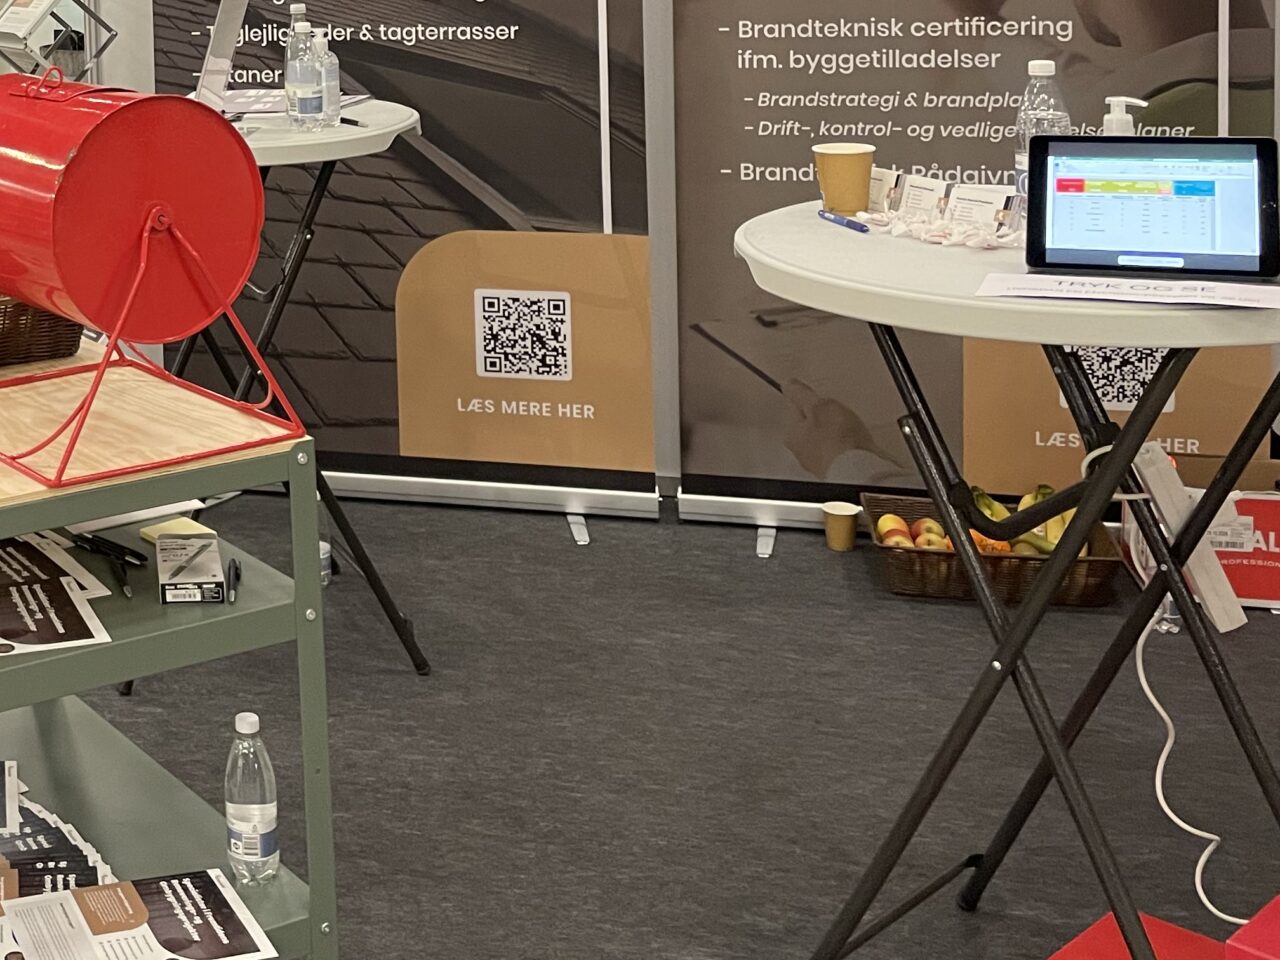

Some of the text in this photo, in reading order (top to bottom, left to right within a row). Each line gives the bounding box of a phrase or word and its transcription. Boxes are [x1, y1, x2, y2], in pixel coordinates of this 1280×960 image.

[359, 24, 374, 40] &
[379, 21, 519, 44] tagterrasser
[738, 16, 904, 39] Brandteknisk
[910, 15, 1073, 41] certificering
[737, 48, 1001, 74] ifm. byggetilladelser
[228, 69, 283, 83] taner
[757, 91, 900, 112] Brandstrategi
[904, 92, 918, 107] &
[923, 92, 1022, 112] brandpla
[819, 121, 902, 136] kontrol-
[907, 124, 935, 142] og
[457, 398, 595, 419] LÆS MERE HER
[1035, 431, 1200, 454] LÆS HER
